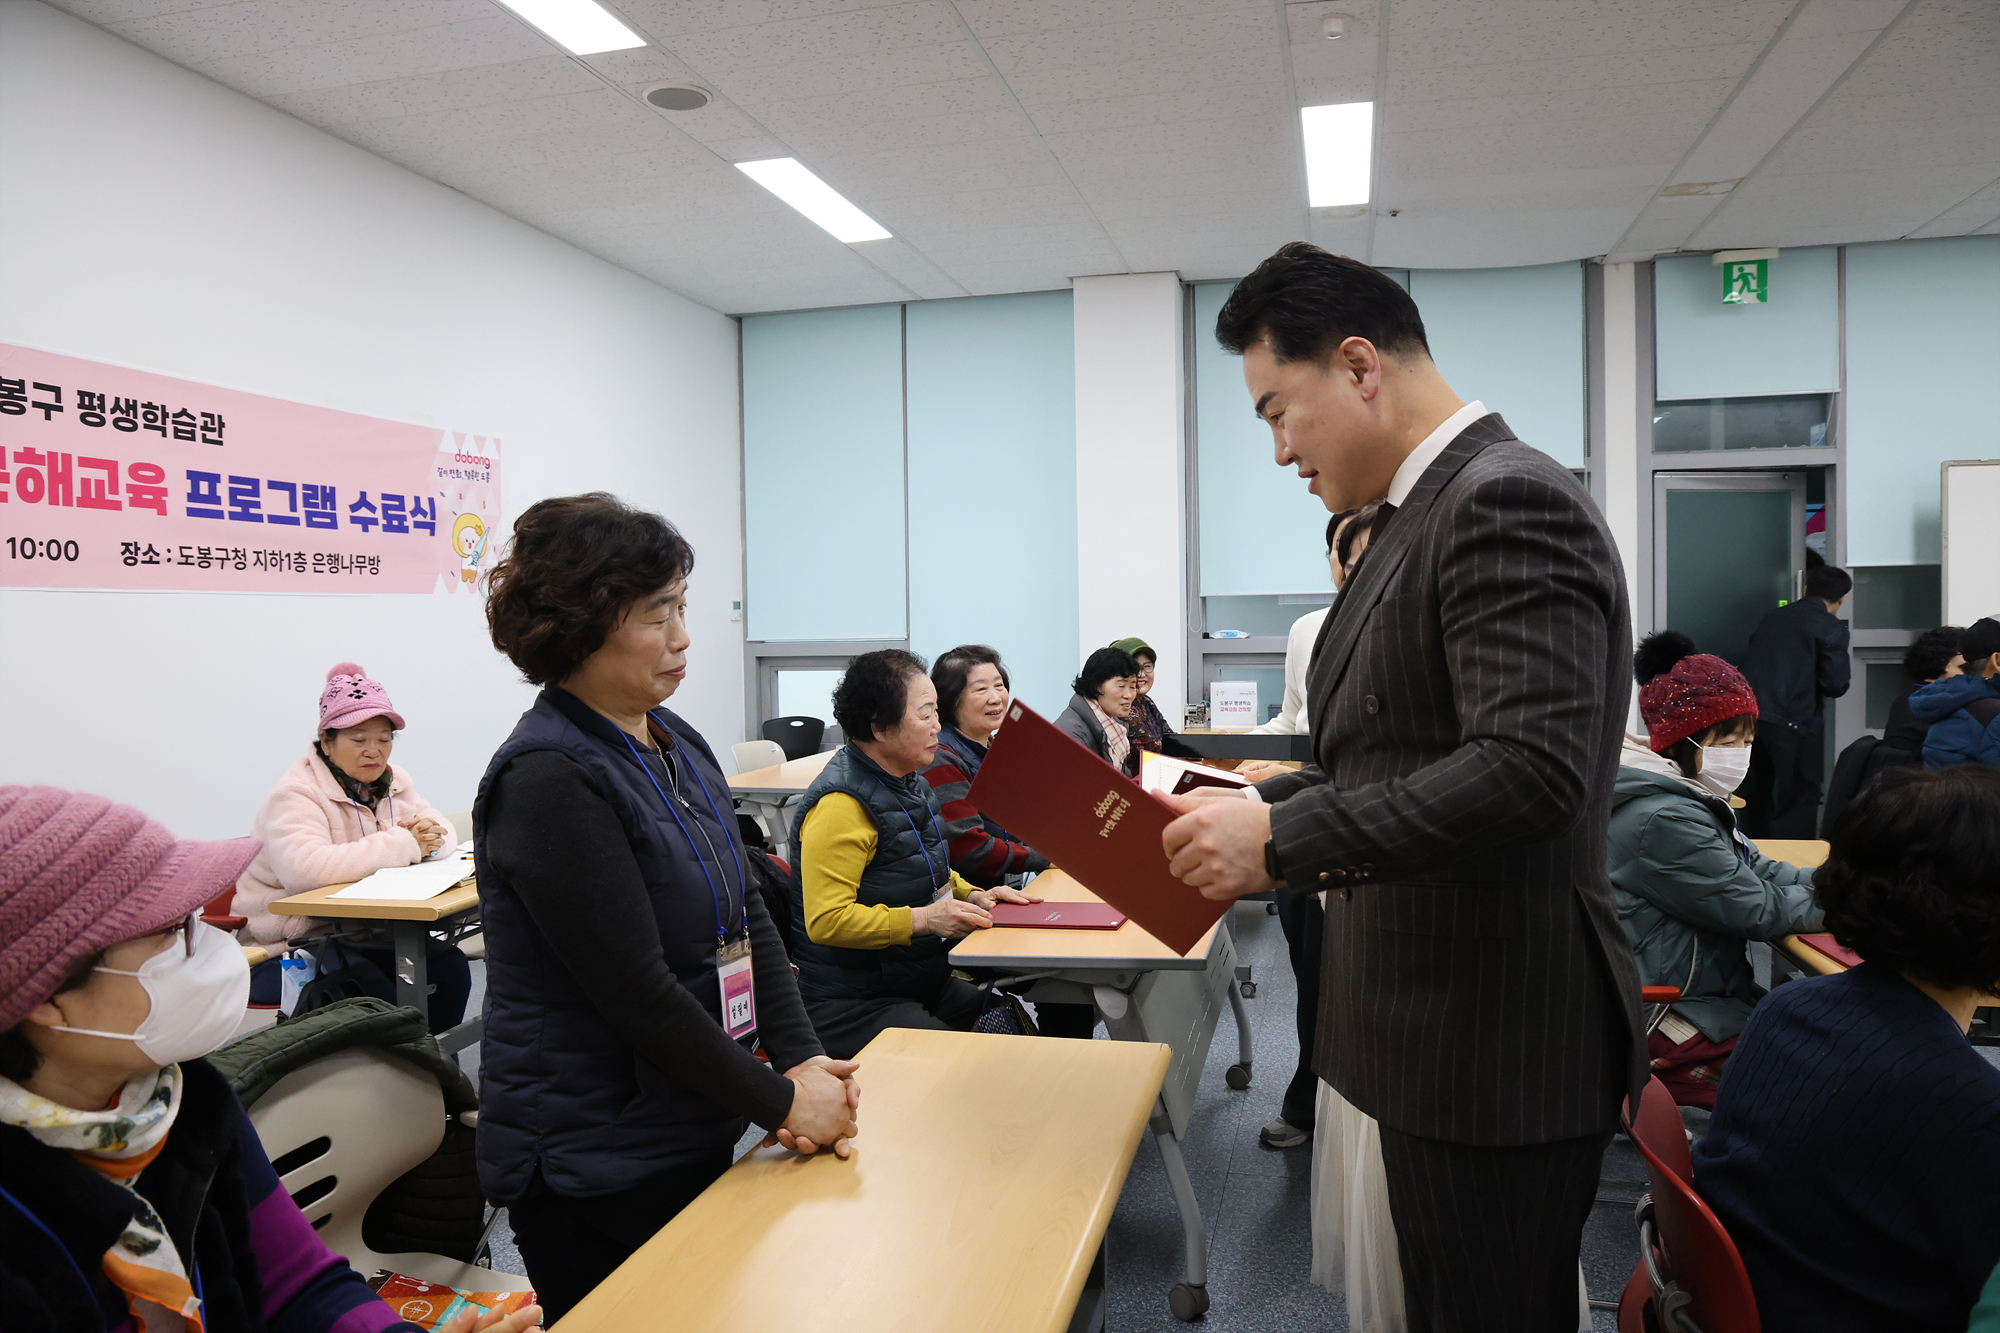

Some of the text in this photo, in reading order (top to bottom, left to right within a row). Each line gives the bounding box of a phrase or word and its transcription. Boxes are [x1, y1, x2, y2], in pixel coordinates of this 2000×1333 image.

[76, 389, 226, 446] 평생학습관
[455, 449, 490, 469] dobong
[0, 446, 436, 537] 해교육 프로그램 수료식
[481, 471, 490, 484] 도봉
[6, 537, 80, 562] 10:00
[177, 545, 247, 571] 도봉구청
[252, 549, 308, 573] 지하1층
[312, 552, 381, 576] 은행나무방
[1093, 789, 1120, 818] dobong
